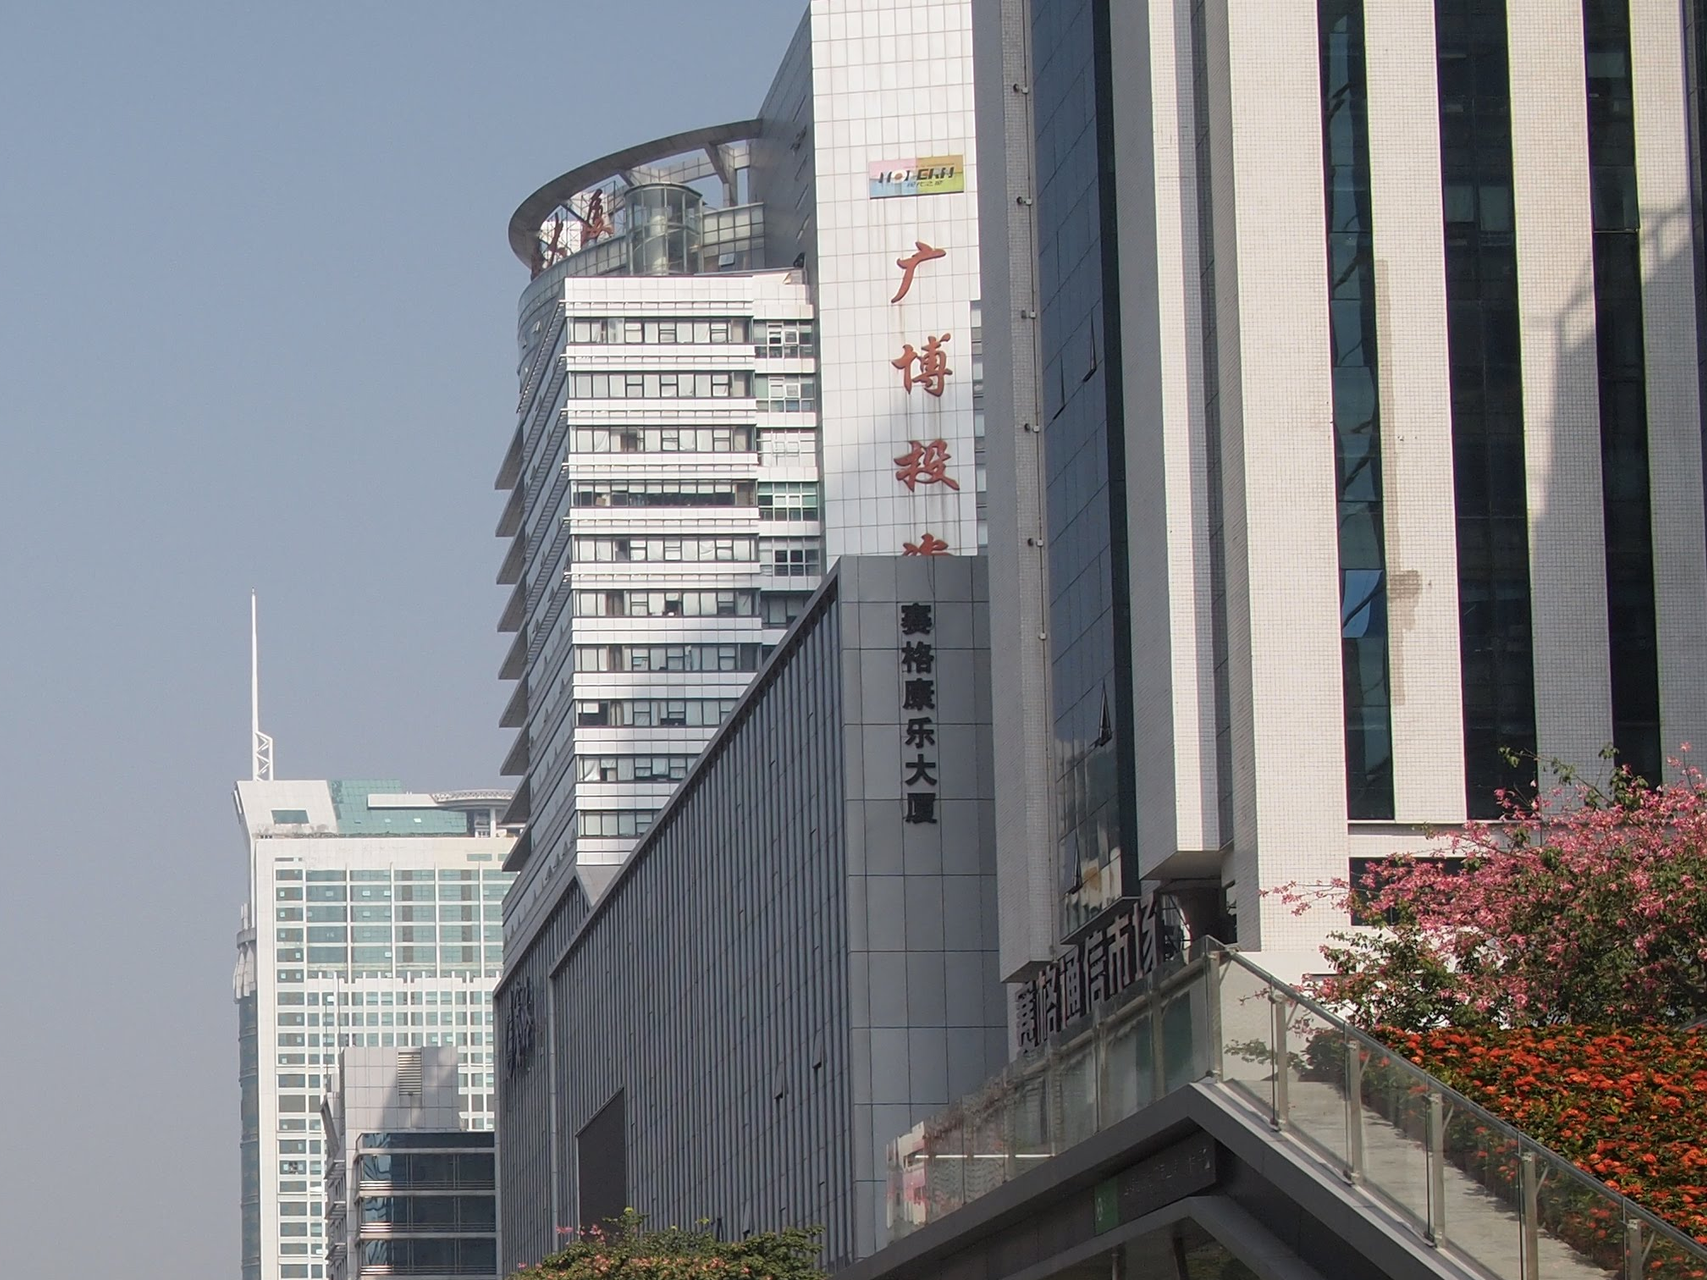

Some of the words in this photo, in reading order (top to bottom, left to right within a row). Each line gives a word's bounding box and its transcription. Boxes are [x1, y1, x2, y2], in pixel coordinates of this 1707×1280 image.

[901, 603, 937, 824] 赛格康乐大厦
[1016, 892, 1158, 1053] 赛格通信市场
